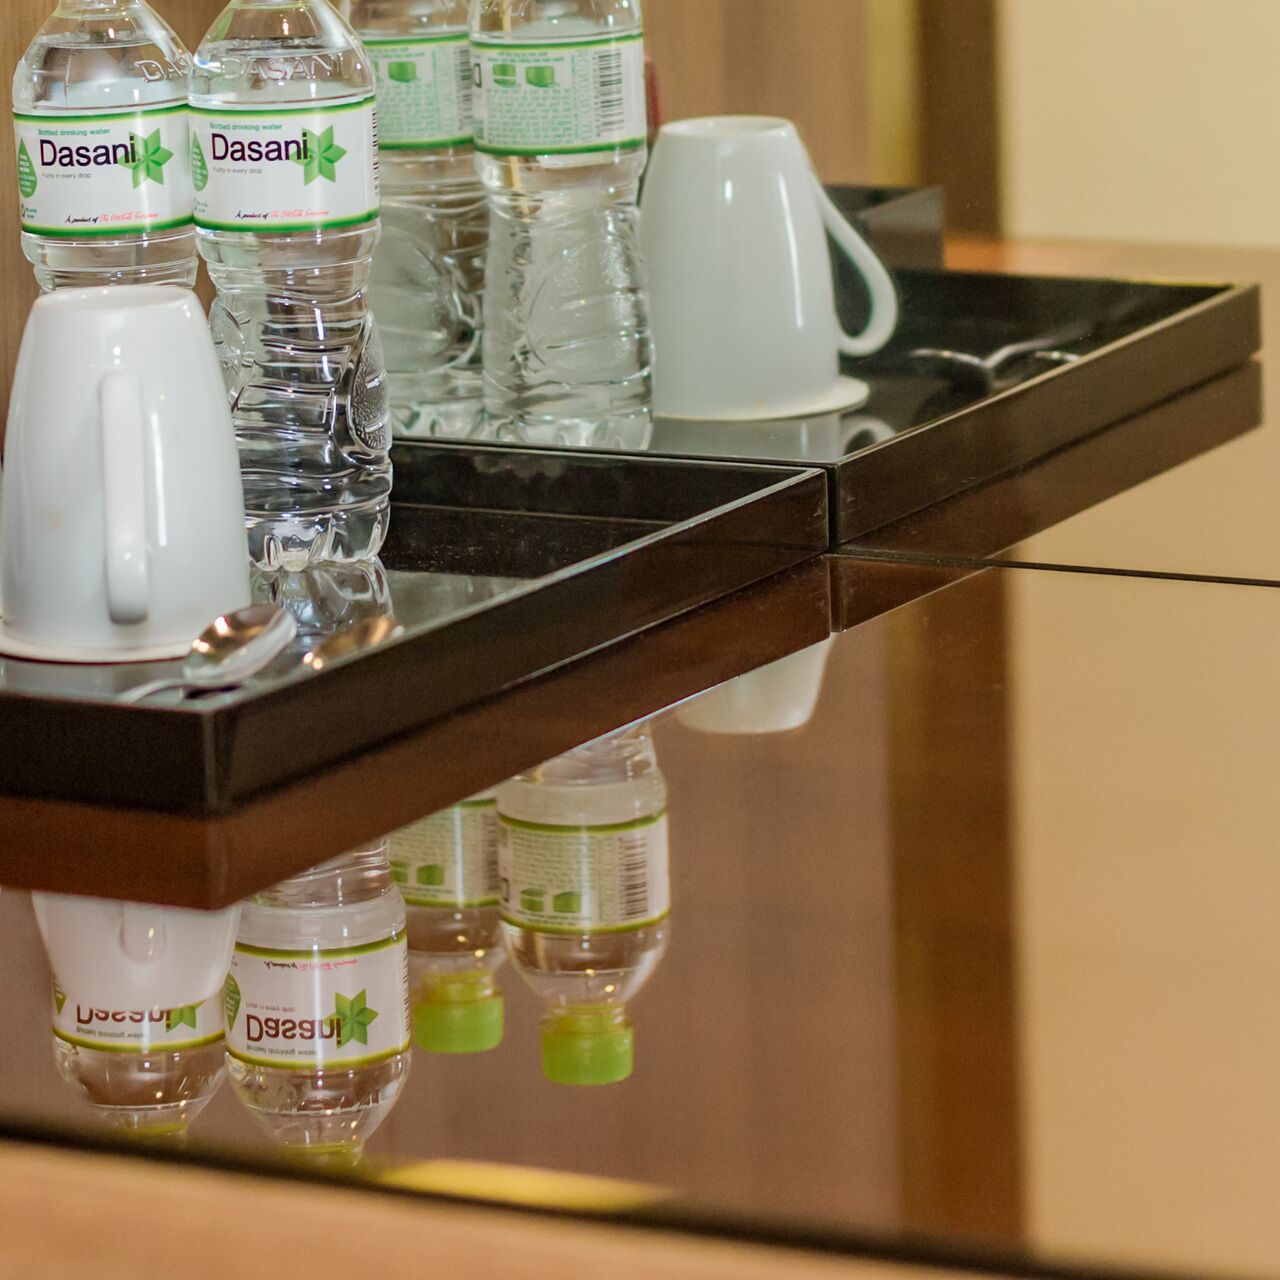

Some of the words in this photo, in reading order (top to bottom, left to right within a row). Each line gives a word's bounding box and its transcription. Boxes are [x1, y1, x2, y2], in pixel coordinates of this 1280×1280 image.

[59, 128, 88, 137] drinking
[89, 127, 111, 135] water
[232, 122, 260, 131] drinking
[262, 122, 282, 130] water
[39, 135, 137, 167] Dasani
[211, 132, 308, 162] Dasani
